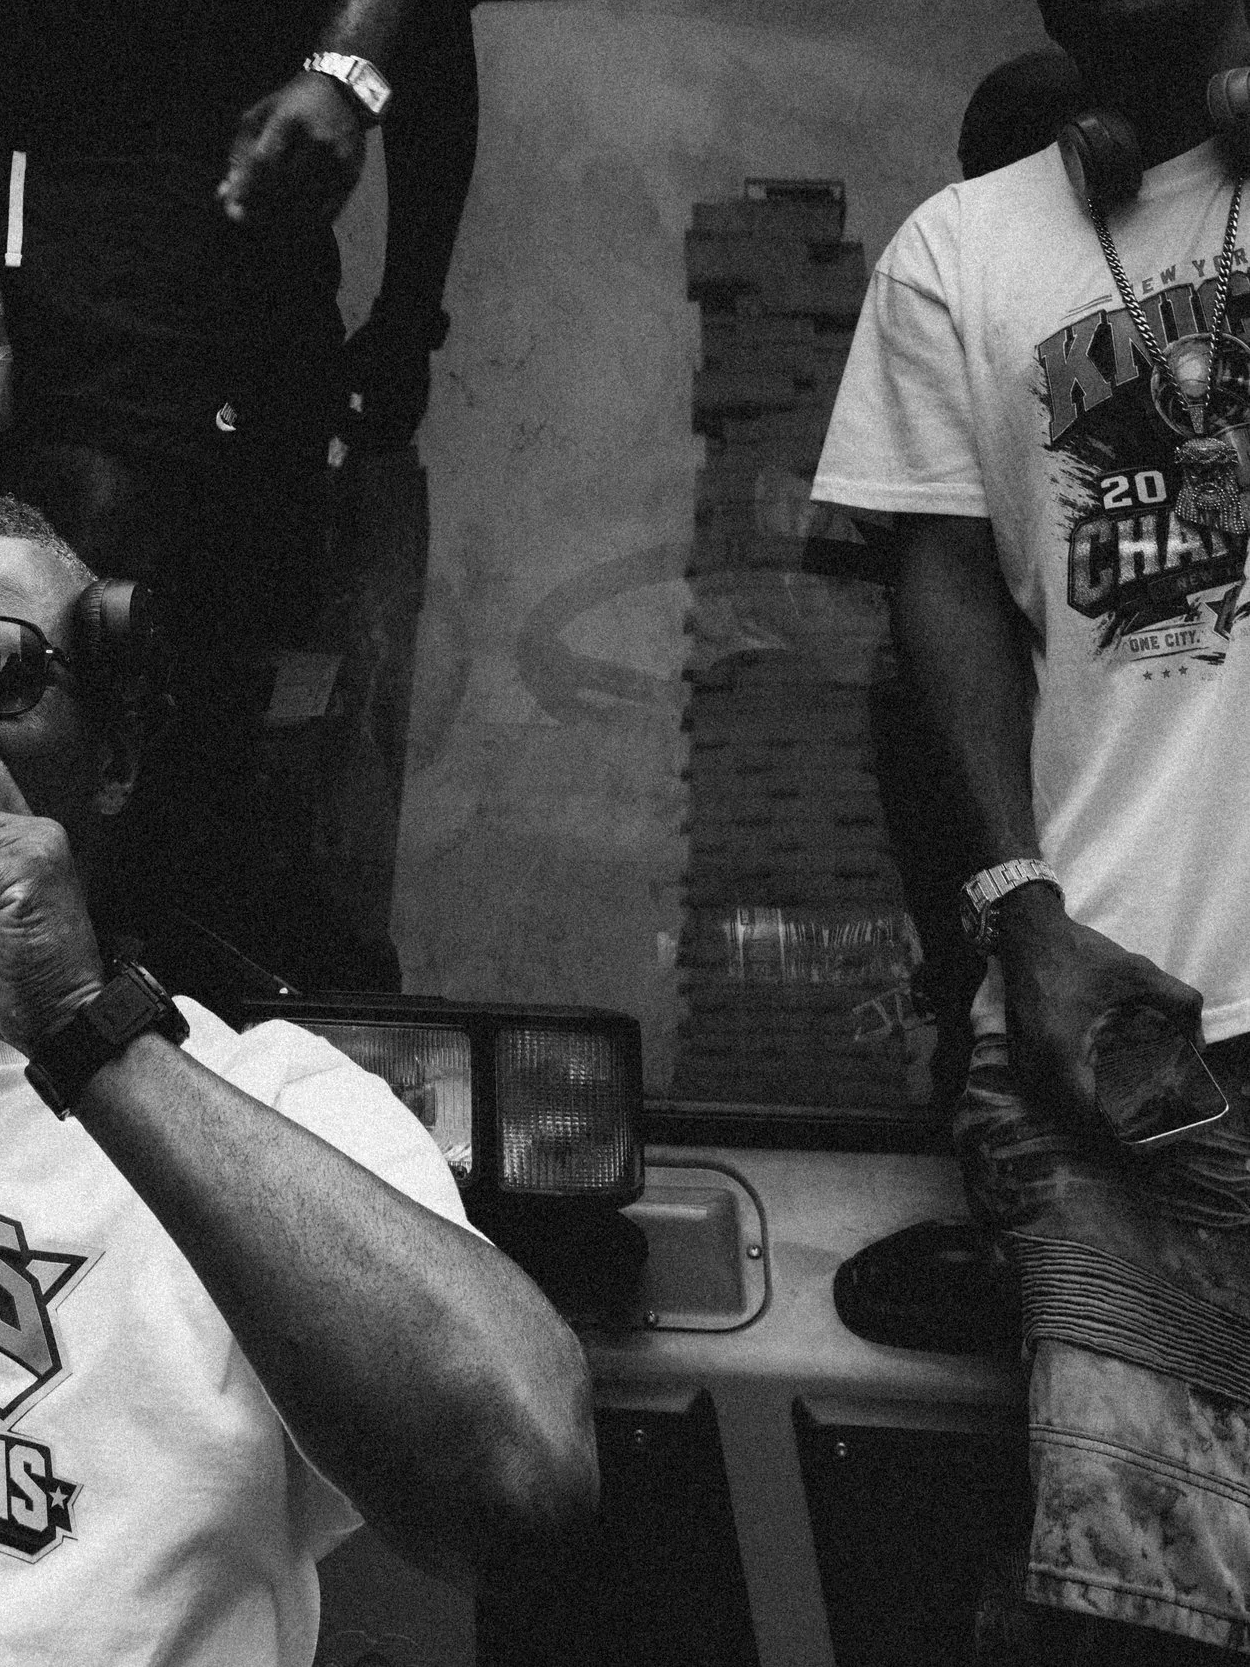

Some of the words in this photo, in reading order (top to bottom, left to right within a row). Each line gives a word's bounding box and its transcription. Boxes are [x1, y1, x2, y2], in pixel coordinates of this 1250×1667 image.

[1126, 264, 1177, 300] EW
[1191, 247, 1250, 278] YOR
[1100, 469, 1167, 511] 20
[1128, 636, 1161, 653] ONE
[1163, 629, 1202, 649] CITY.
